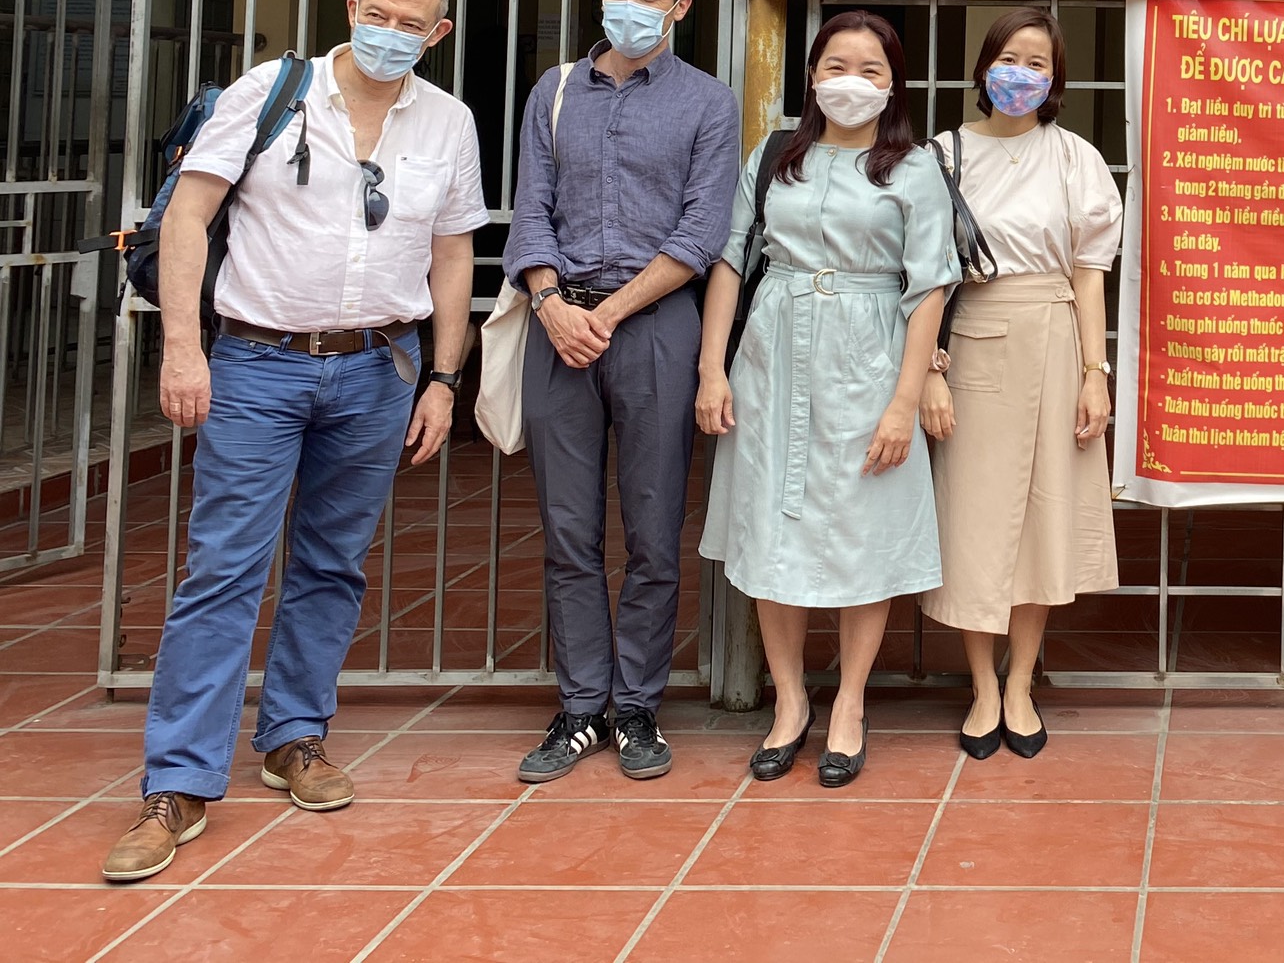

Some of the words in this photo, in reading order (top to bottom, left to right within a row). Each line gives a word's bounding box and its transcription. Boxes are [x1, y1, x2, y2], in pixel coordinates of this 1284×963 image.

[1172, 10, 1212, 40] TIÊU
[1218, 12, 1250, 42] CHÍ
[1180, 43, 1206, 80] ĐỂ
[1210, 56, 1264, 90] ĐƯỢC
[1166, 97, 1177, 113] 1.
[1181, 97, 1201, 117] Đạt
[1206, 97, 1229, 116] liều
[1233, 101, 1254, 119] duy
[1258, 102, 1272, 119] trì
[1177, 123, 1208, 142] giảm
[1210, 124, 1242, 145] liều).
[1162, 151, 1173, 167] 2.
[1175, 151, 1197, 168] Xét
[1198, 153, 1243, 173] nghiệm
[1245, 156, 1275, 172] nước
[1175, 179, 1206, 197] trong
[1208, 180, 1216, 196] 2
[1218, 181, 1252, 199] tháng
[1253, 180, 1276, 200] gần
[1161, 205, 1172, 222] 3.
[1175, 206, 1213, 225] Không
[1216, 206, 1231, 223] bỏ
[1234, 207, 1257, 225] liều
[1173, 230, 1196, 251] gần
[1198, 234, 1221, 252] đây.
[1160, 260, 1170, 276] 4.
[1175, 261, 1208, 279] Trong
[1213, 262, 1219, 278] 1
[1224, 262, 1250, 279] năm
[1254, 266, 1276, 281] qua
[1172, 286, 1194, 305] của
[1196, 290, 1212, 305] cơ
[1213, 288, 1227, 306] sở
[1167, 315, 1195, 334] Đóng
[1197, 317, 1216, 334] phí
[1218, 315, 1248, 336] uống
[1250, 316, 1283, 335] thuốc
[1167, 341, 1202, 360] Không
[1204, 345, 1226, 364] gây
[1227, 343, 1243, 362] rối
[1246, 343, 1269, 362] mất
[1167, 367, 1192, 385] Xuất
[1193, 371, 1220, 389] trình
[1222, 371, 1242, 390] thẻ
[1243, 371, 1272, 392] uống
[1165, 396, 1189, 415] Tuân
[1191, 398, 1210, 416] thủ
[1212, 398, 1242, 420] uống
[1244, 400, 1278, 418] thuốc
[1161, 424, 1186, 443] Tuân
[1189, 426, 1208, 445] thủ
[1210, 428, 1234, 449] lịch
[1235, 429, 1270, 446] khám
